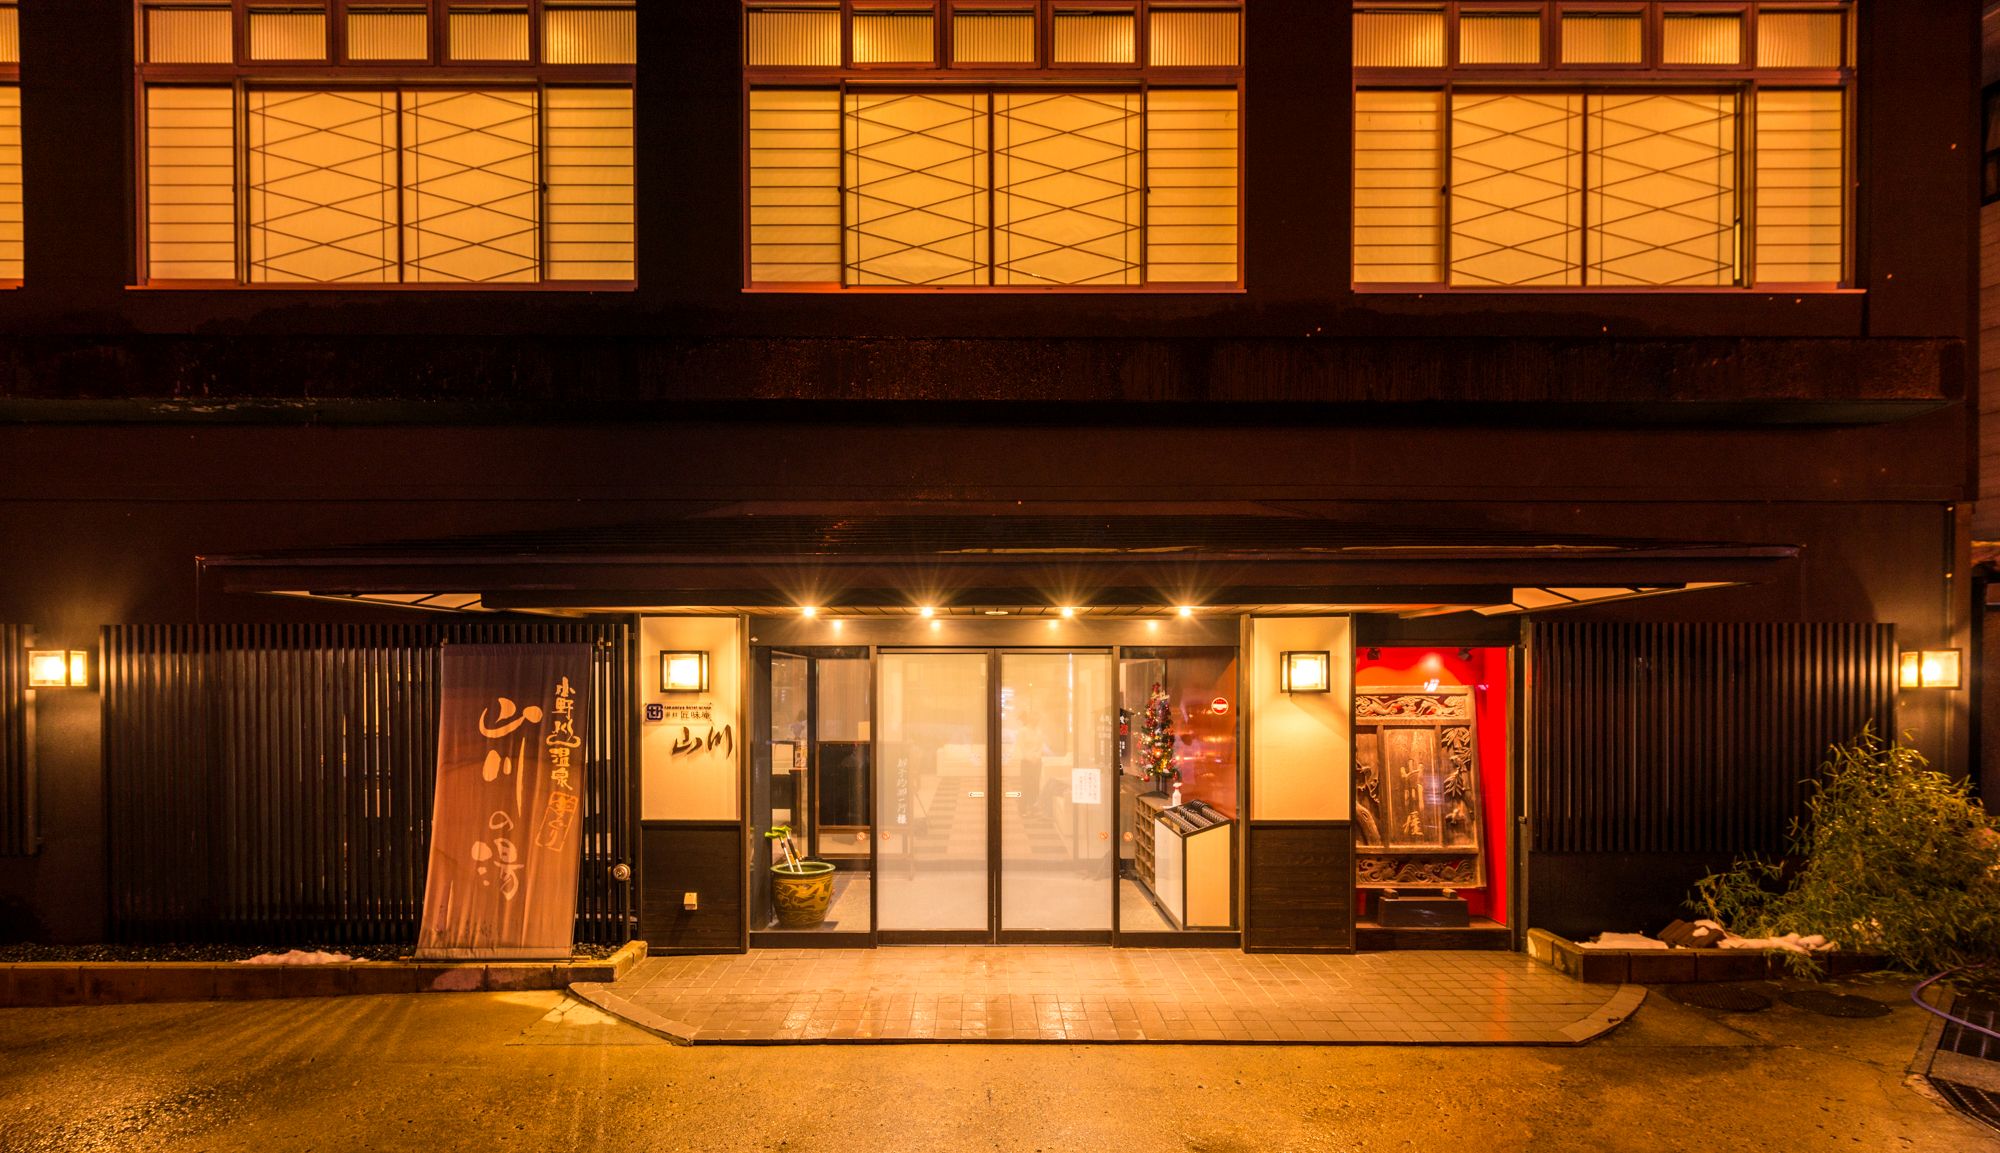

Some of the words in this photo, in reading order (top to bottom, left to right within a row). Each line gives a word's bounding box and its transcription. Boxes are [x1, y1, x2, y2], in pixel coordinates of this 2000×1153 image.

[546, 676, 581, 790] 小野川温泉
[672, 724, 733, 760] 山川
[471, 697, 544, 901] 山川の湯
